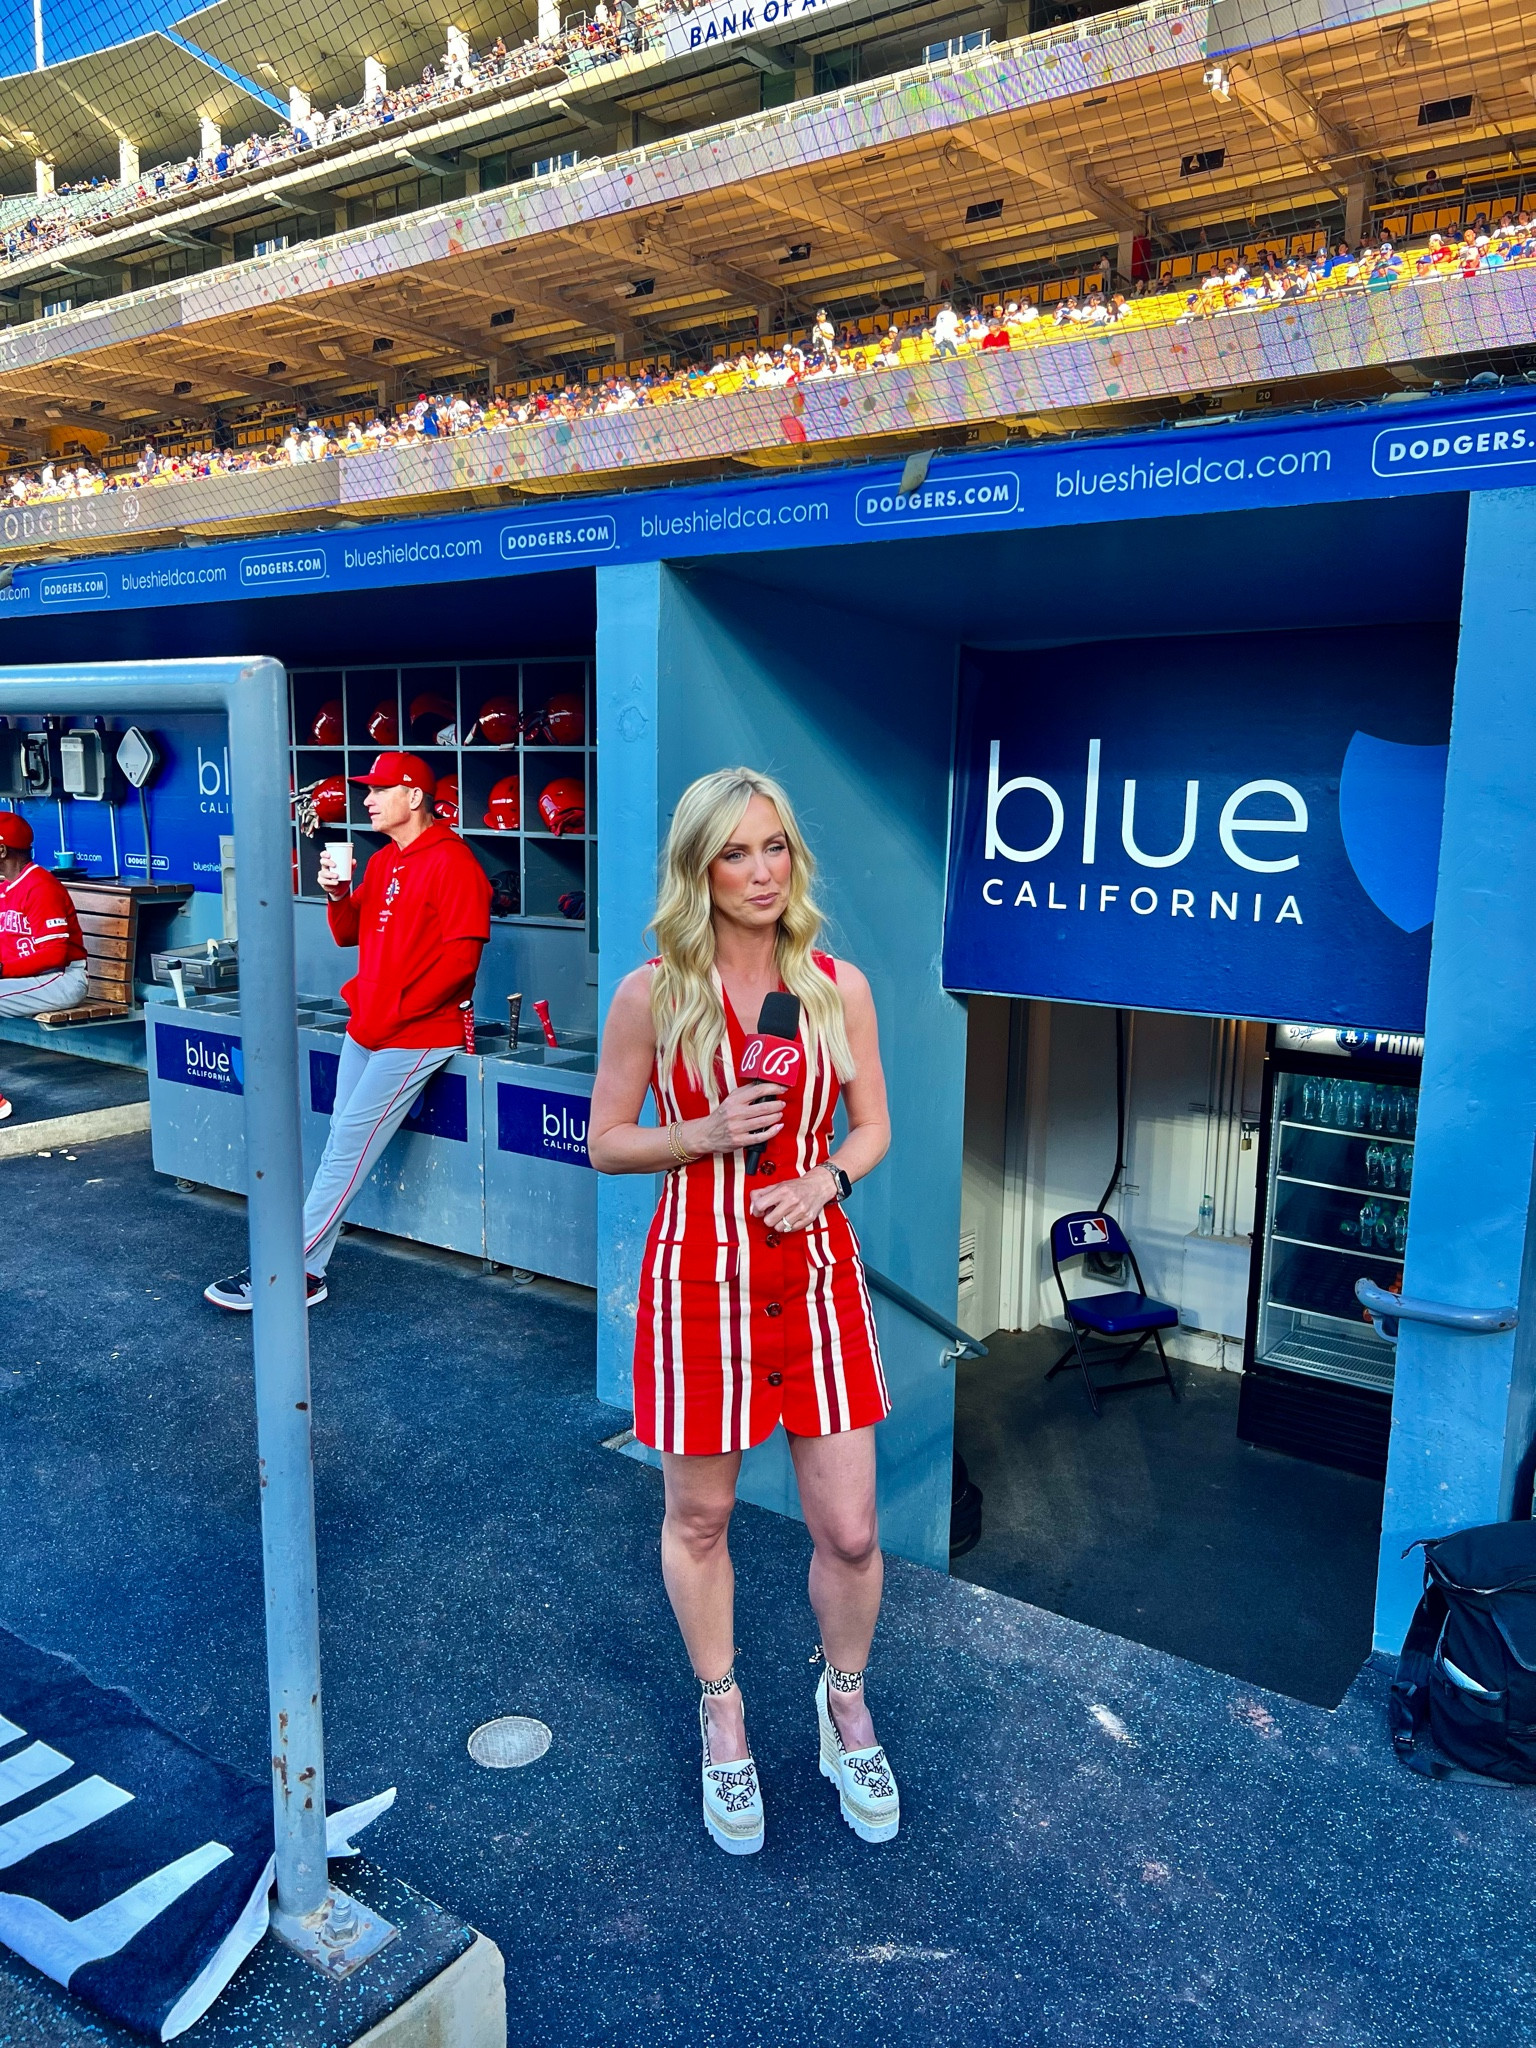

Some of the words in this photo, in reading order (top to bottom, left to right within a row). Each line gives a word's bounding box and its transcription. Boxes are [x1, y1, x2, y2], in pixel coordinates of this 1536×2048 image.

[689, 8, 755, 48] BANK
[44, 580, 104, 596] DODGERS.COM
[122, 566, 227, 591] blueshieldca.com
[246, 557, 321, 577] DODGERS.COM
[344, 537, 482, 568] blueshieldca.com
[507, 526, 609, 550] DODGERS.COM
[641, 501, 829, 538] blueshieldca.com
[866, 484, 1009, 514] DODGERS.COM
[1055, 448, 1332, 498] blueshieldca.com
[1389, 429, 1535, 462] DODGERS.
[200, 801, 231, 814] CALI
[984, 738, 1309, 874] blue
[193, 861, 222, 872] blueshiel
[982, 878, 1304, 925] CALIFORNIA
[186, 1039, 229, 1072] blue
[763, 1046, 800, 1076] B
[187, 1068, 231, 1082] CALIFORNIA
[543, 1138, 587, 1154] CALIFOR
